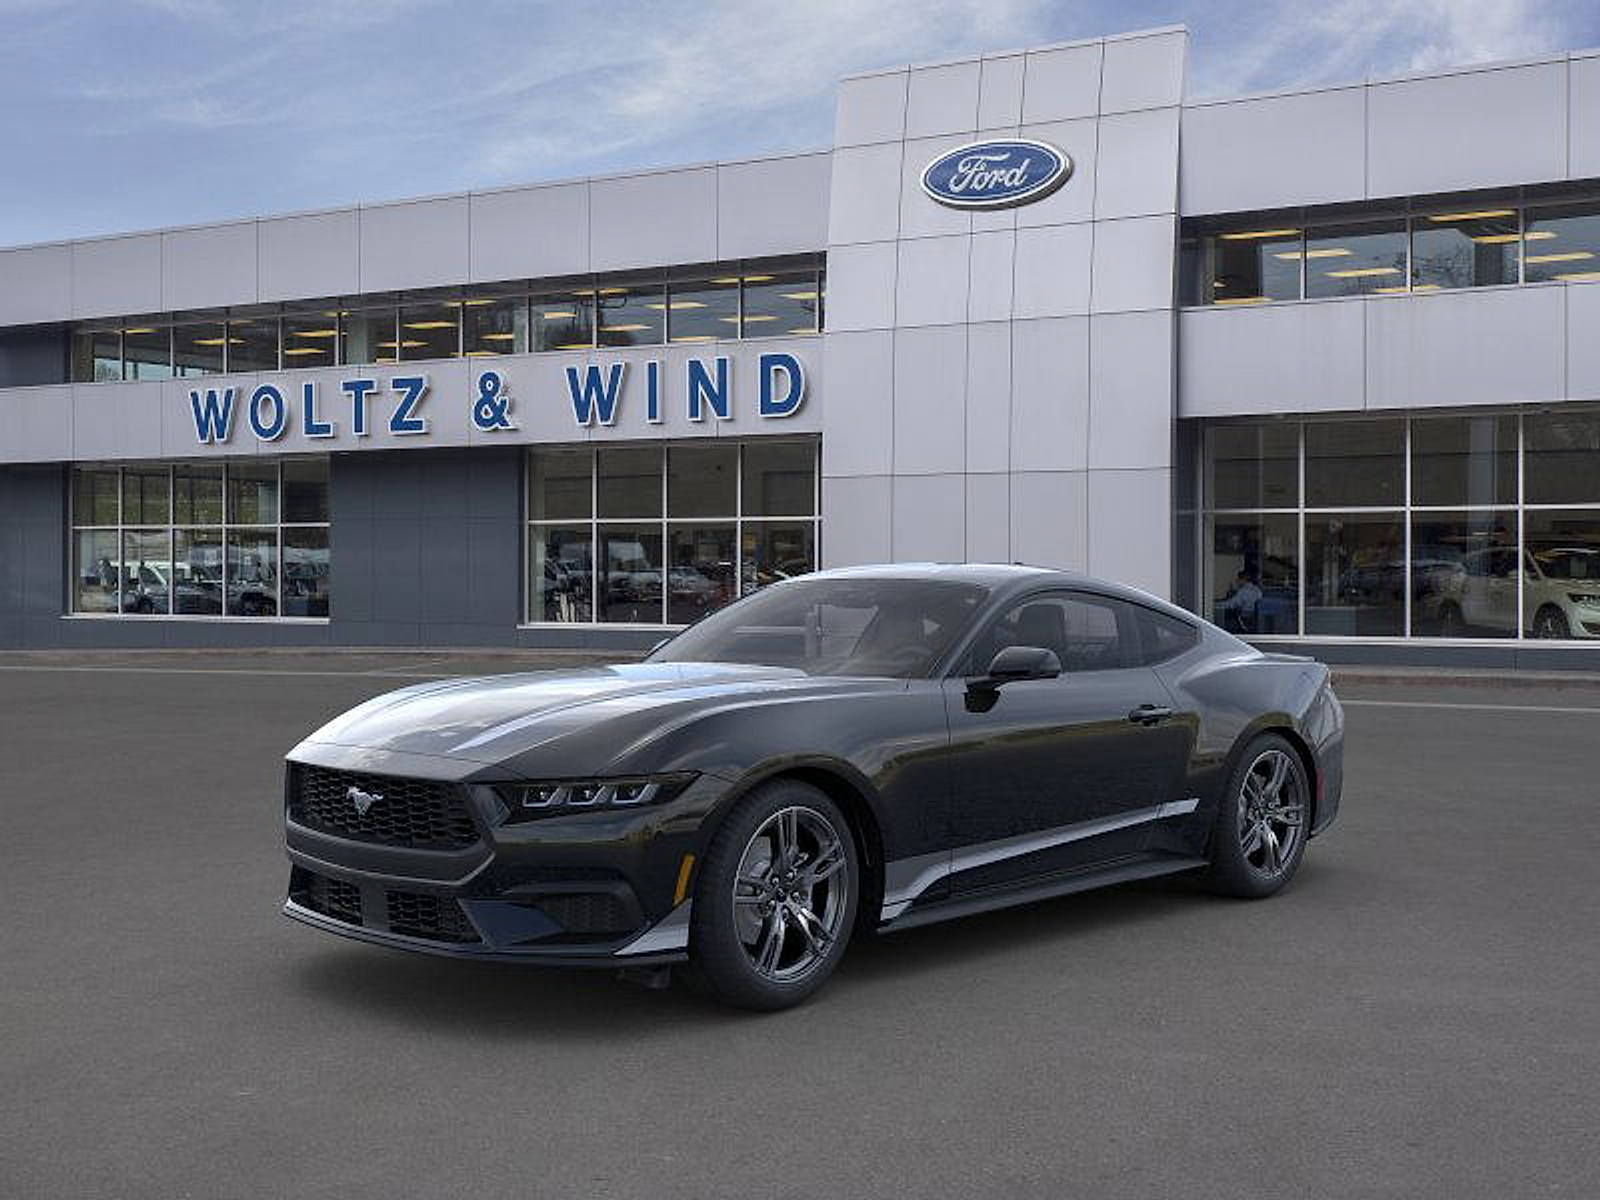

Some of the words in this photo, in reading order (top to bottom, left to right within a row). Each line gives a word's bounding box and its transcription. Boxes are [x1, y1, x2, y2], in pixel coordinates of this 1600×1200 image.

[950, 152, 1031, 193] Ford
[190, 375, 429, 443] WOLTZ
[472, 371, 513, 430] &
[565, 351, 806, 426] WIND
